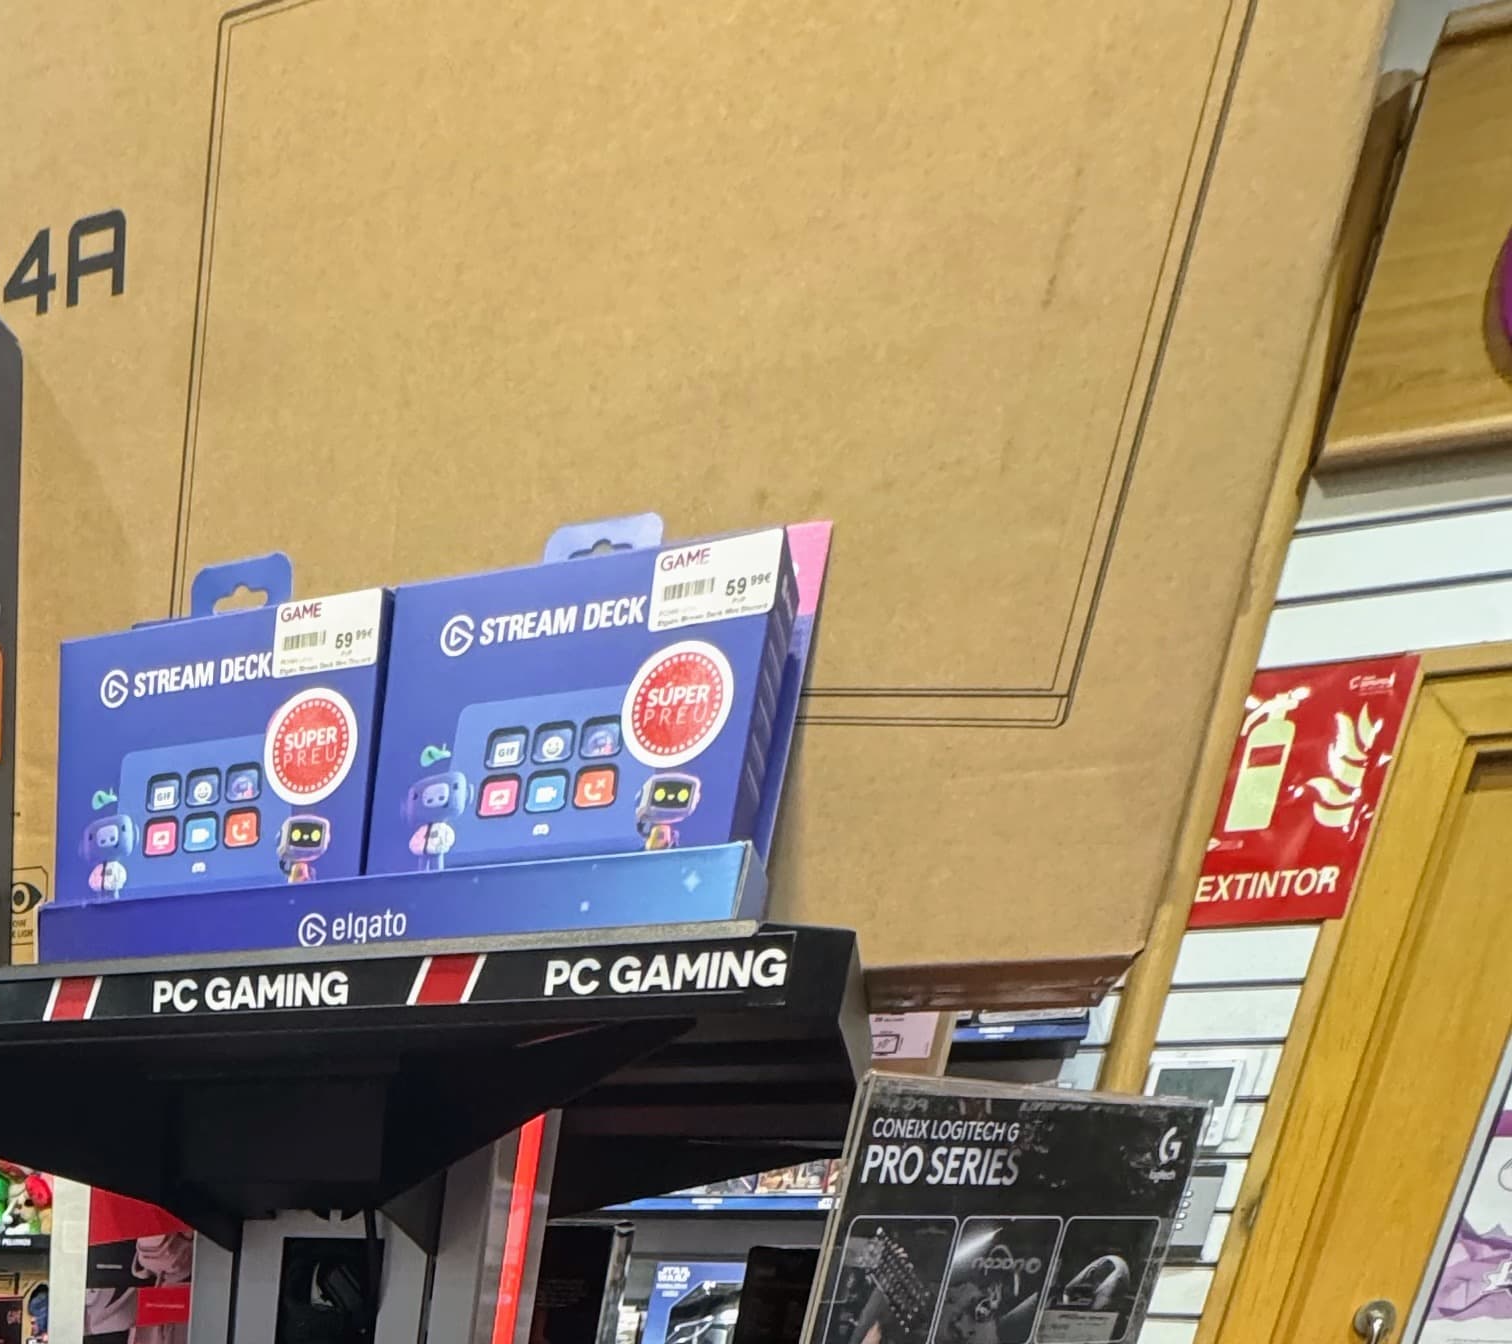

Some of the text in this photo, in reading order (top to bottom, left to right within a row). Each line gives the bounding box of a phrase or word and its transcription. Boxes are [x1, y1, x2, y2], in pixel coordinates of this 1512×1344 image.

[660, 548, 711, 572] GAME
[725, 577, 747, 598] 59
[281, 602, 322, 622] GAME
[479, 596, 646, 646] STREAM DECK
[335, 632, 353, 650] 59
[134, 652, 273, 698] STREAM DECK
[647, 684, 710, 707] SÚPER
[643, 704, 709, 727] PREU
[284, 726, 338, 750] SÚPER
[282, 745, 339, 768] PREU
[497, 747, 516, 759] GIF
[157, 791, 171, 801] GIF
[1195, 865, 1340, 903] EXTINTOR
[330, 909, 408, 945] elgato
[151, 978, 199, 1013] PC
[204, 969, 349, 1011] GAMING
[543, 957, 602, 996] PC
[609, 948, 788, 994] GAMING
[872, 1118, 1021, 1142] CONEIX LOGITECH G
[861, 1145, 1022, 1186] PRO SERIES
